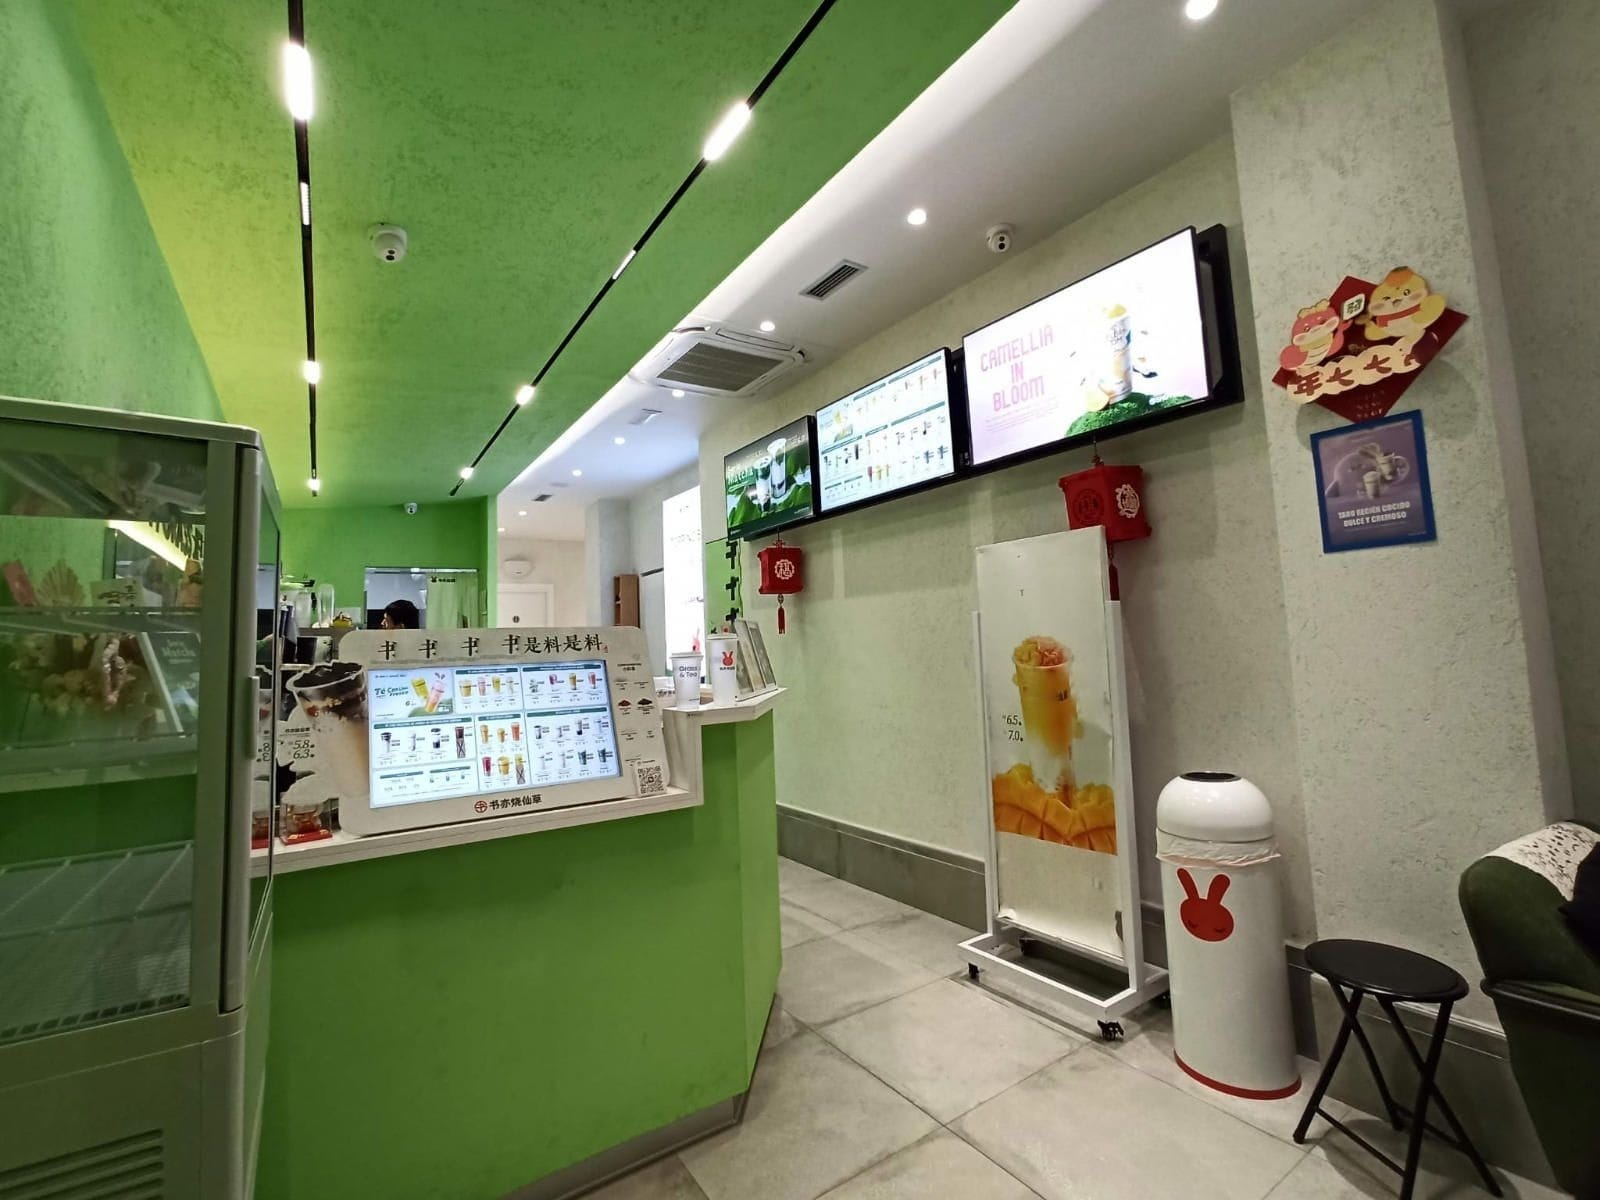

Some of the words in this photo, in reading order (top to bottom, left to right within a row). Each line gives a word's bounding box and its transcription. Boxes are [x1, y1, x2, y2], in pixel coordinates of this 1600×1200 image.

[980, 325, 1054, 372] CAMELLIA
[1010, 361, 1024, 384] IN
[993, 375, 1045, 412] BLOOM
[1343, 517, 1366, 527] DULCE
[1371, 511, 1407, 523] CREMOSO
[679, 665, 698, 673] Grass
